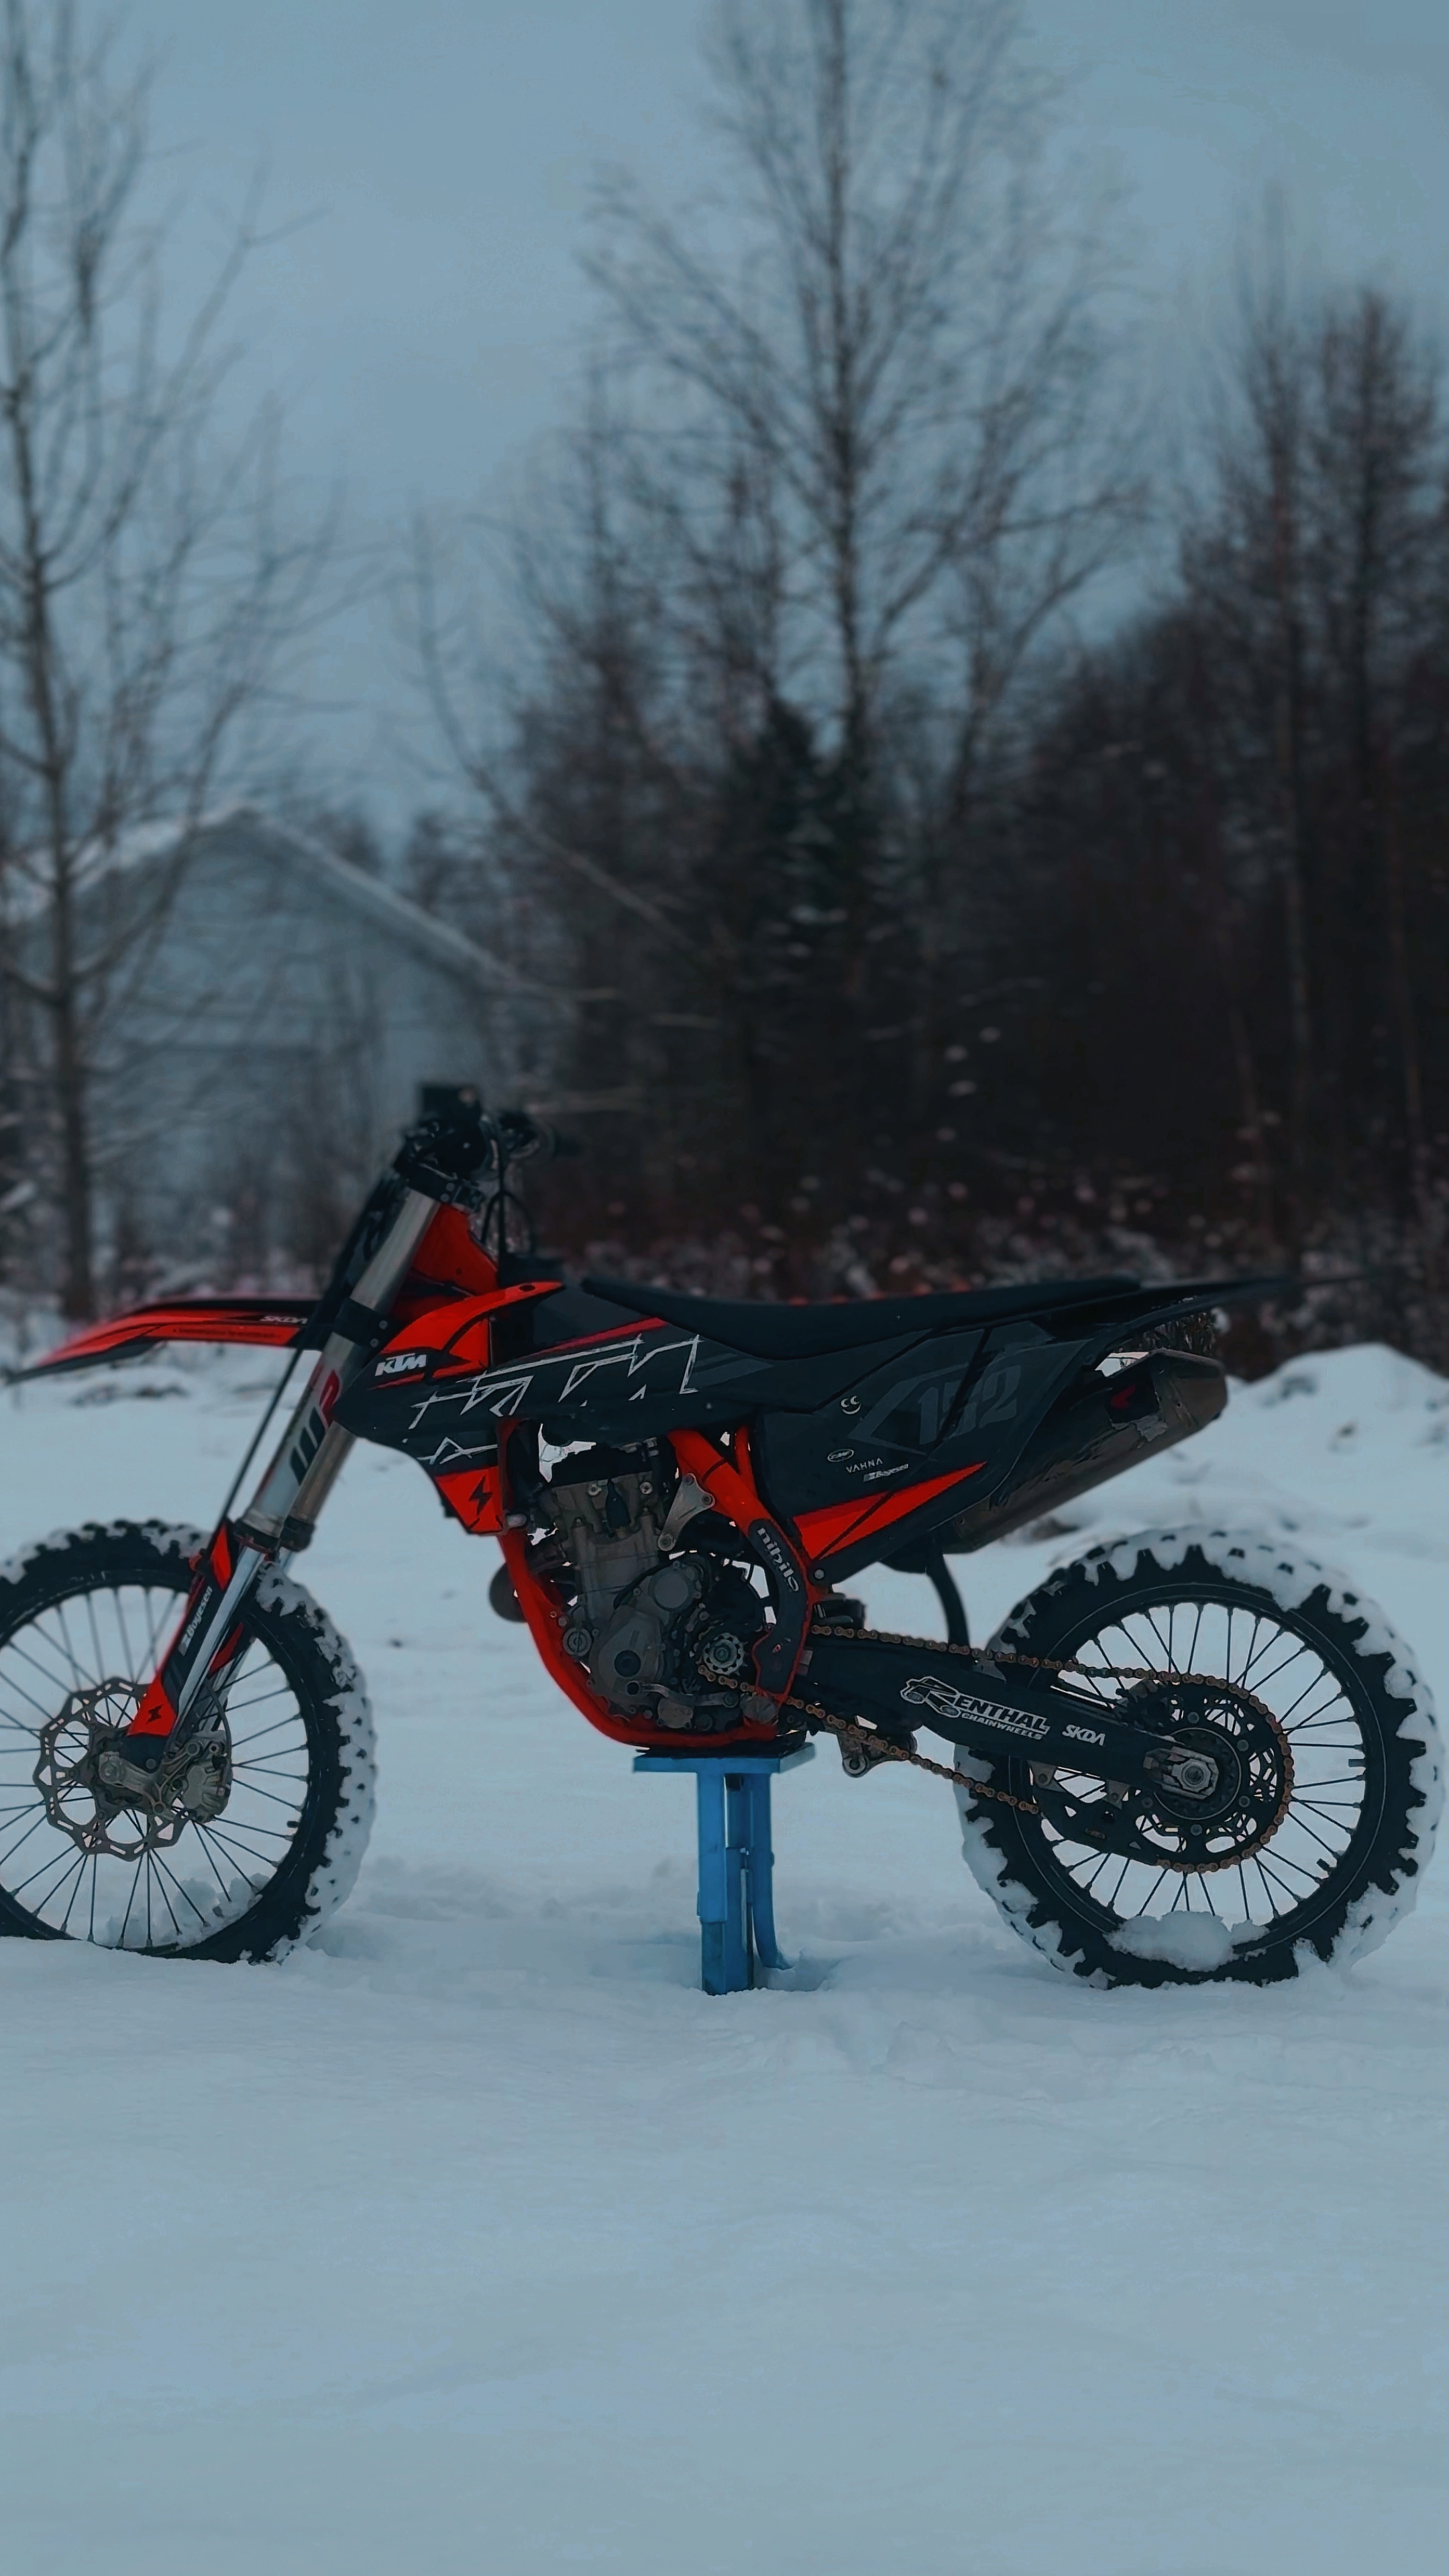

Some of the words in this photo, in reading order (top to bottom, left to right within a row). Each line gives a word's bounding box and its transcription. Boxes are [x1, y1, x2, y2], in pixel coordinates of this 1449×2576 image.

[375, 1352, 427, 1377] KTM
[846, 1457, 883, 1473] VAHNA
[757, 1527, 800, 1592] nihilo
[961, 1711, 1044, 1741] CHAINWHEELS
[1061, 1723, 1106, 1747] SKDA
